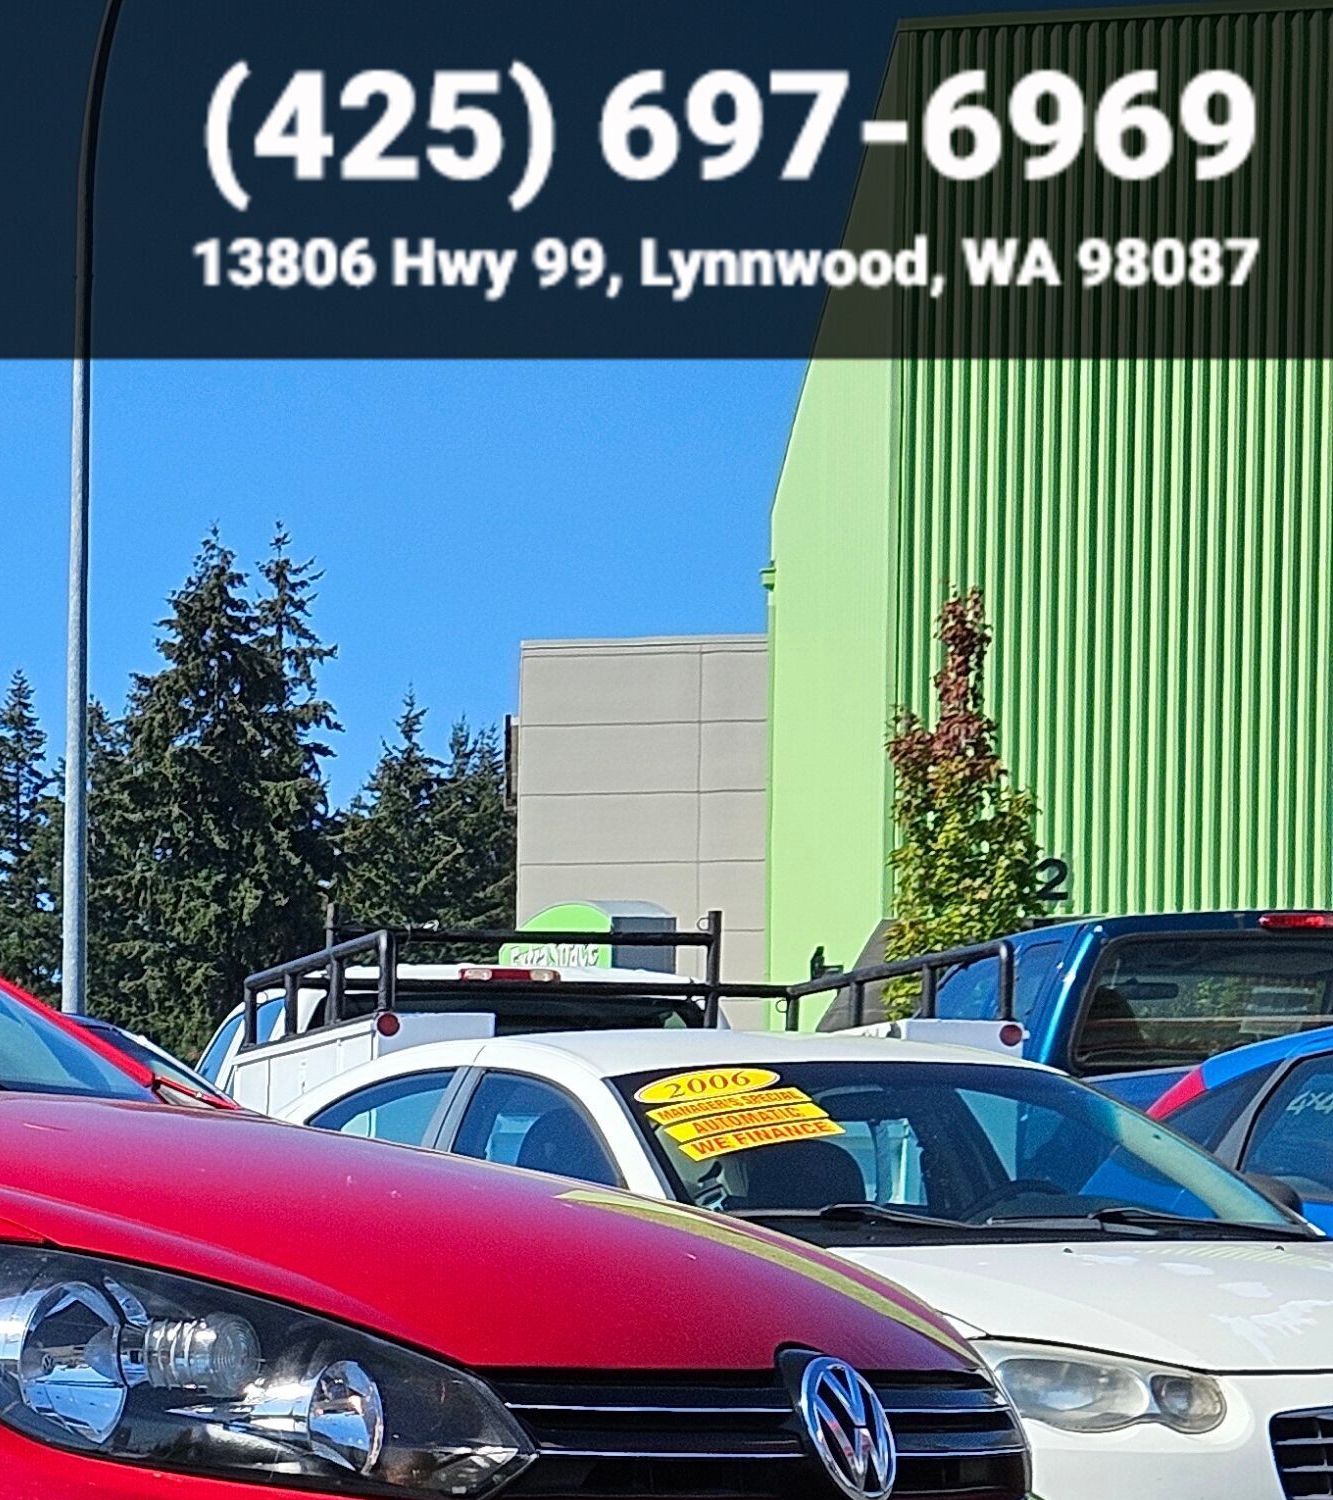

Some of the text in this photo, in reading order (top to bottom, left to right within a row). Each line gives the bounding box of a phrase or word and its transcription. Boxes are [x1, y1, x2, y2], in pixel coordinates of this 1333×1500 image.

[663, 1069, 752, 1101] 2006
[741, 1089, 804, 1108] SPECIAL
[692, 1106, 807, 1136] AUTOMATIC
[690, 1119, 833, 1156] WE FINANCE
